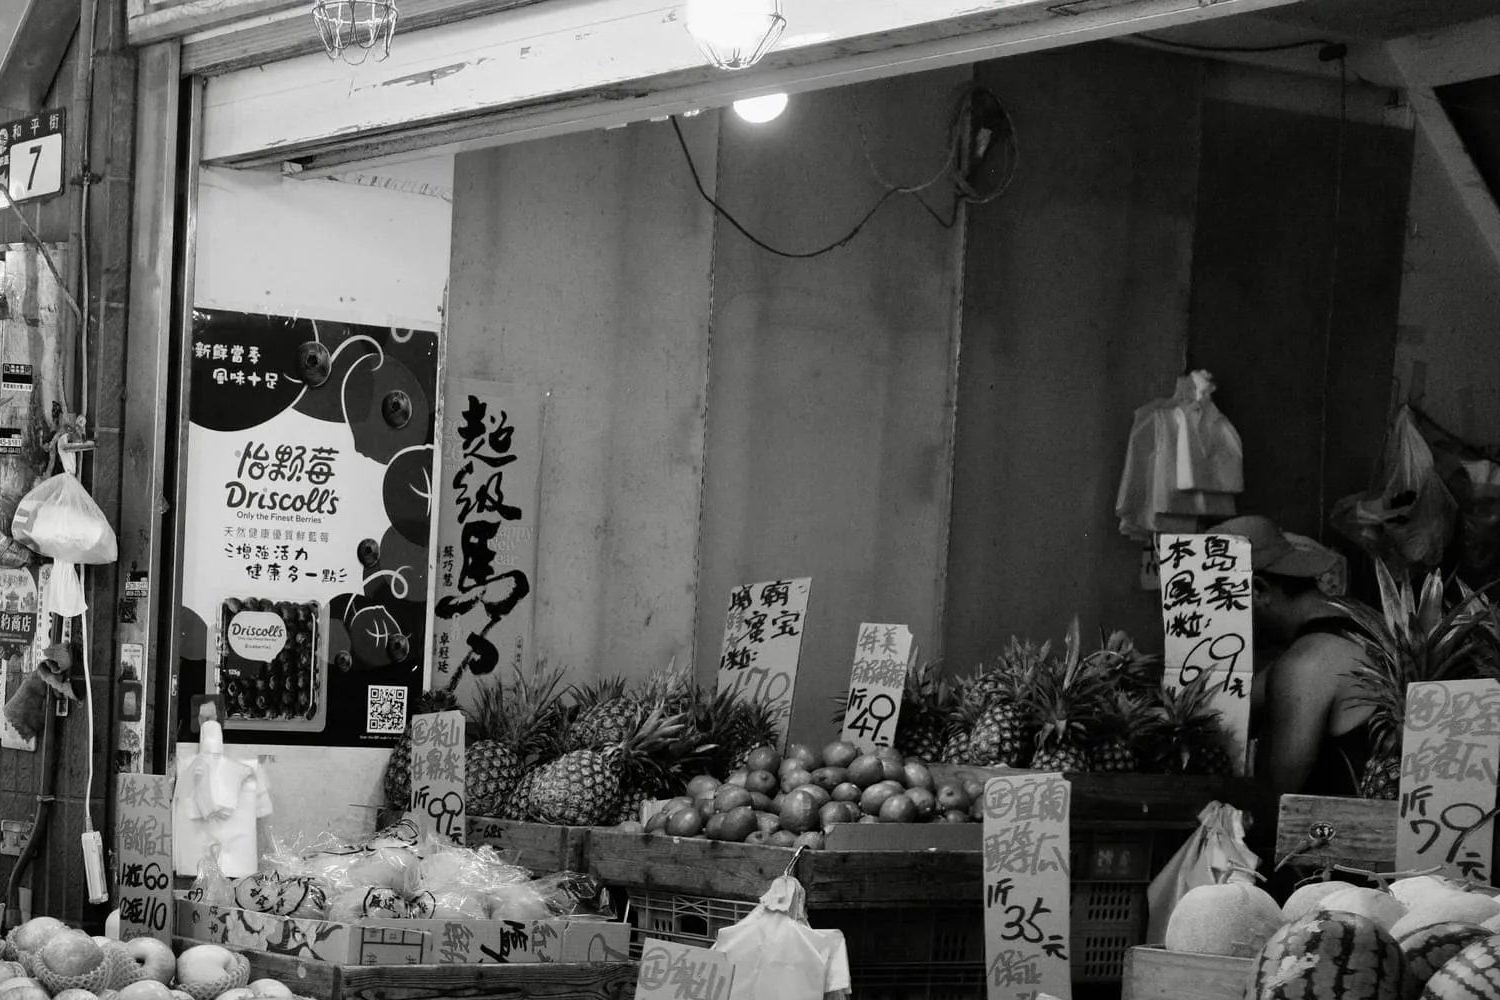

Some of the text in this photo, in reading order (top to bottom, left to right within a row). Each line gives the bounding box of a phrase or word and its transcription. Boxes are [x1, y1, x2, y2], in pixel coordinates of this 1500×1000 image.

[27, 144, 42, 191] 7
[195, 341, 261, 366] 新鮮當季
[213, 368, 279, 389] 風味十足
[225, 481, 340, 515] Driscoll's
[237, 511, 322, 524] Only the Finest Berries
[236, 543, 308, 560] 增強活力
[246, 563, 337, 583] 健康多一點
[231, 623, 284, 639] Driscoll's
[1179, 633, 1246, 692] 69
[848, 694, 896, 741] 49
[428, 791, 463, 836] 99
[1001, 897, 1052, 943] 35
[1042, 935, 1069, 960] 元
